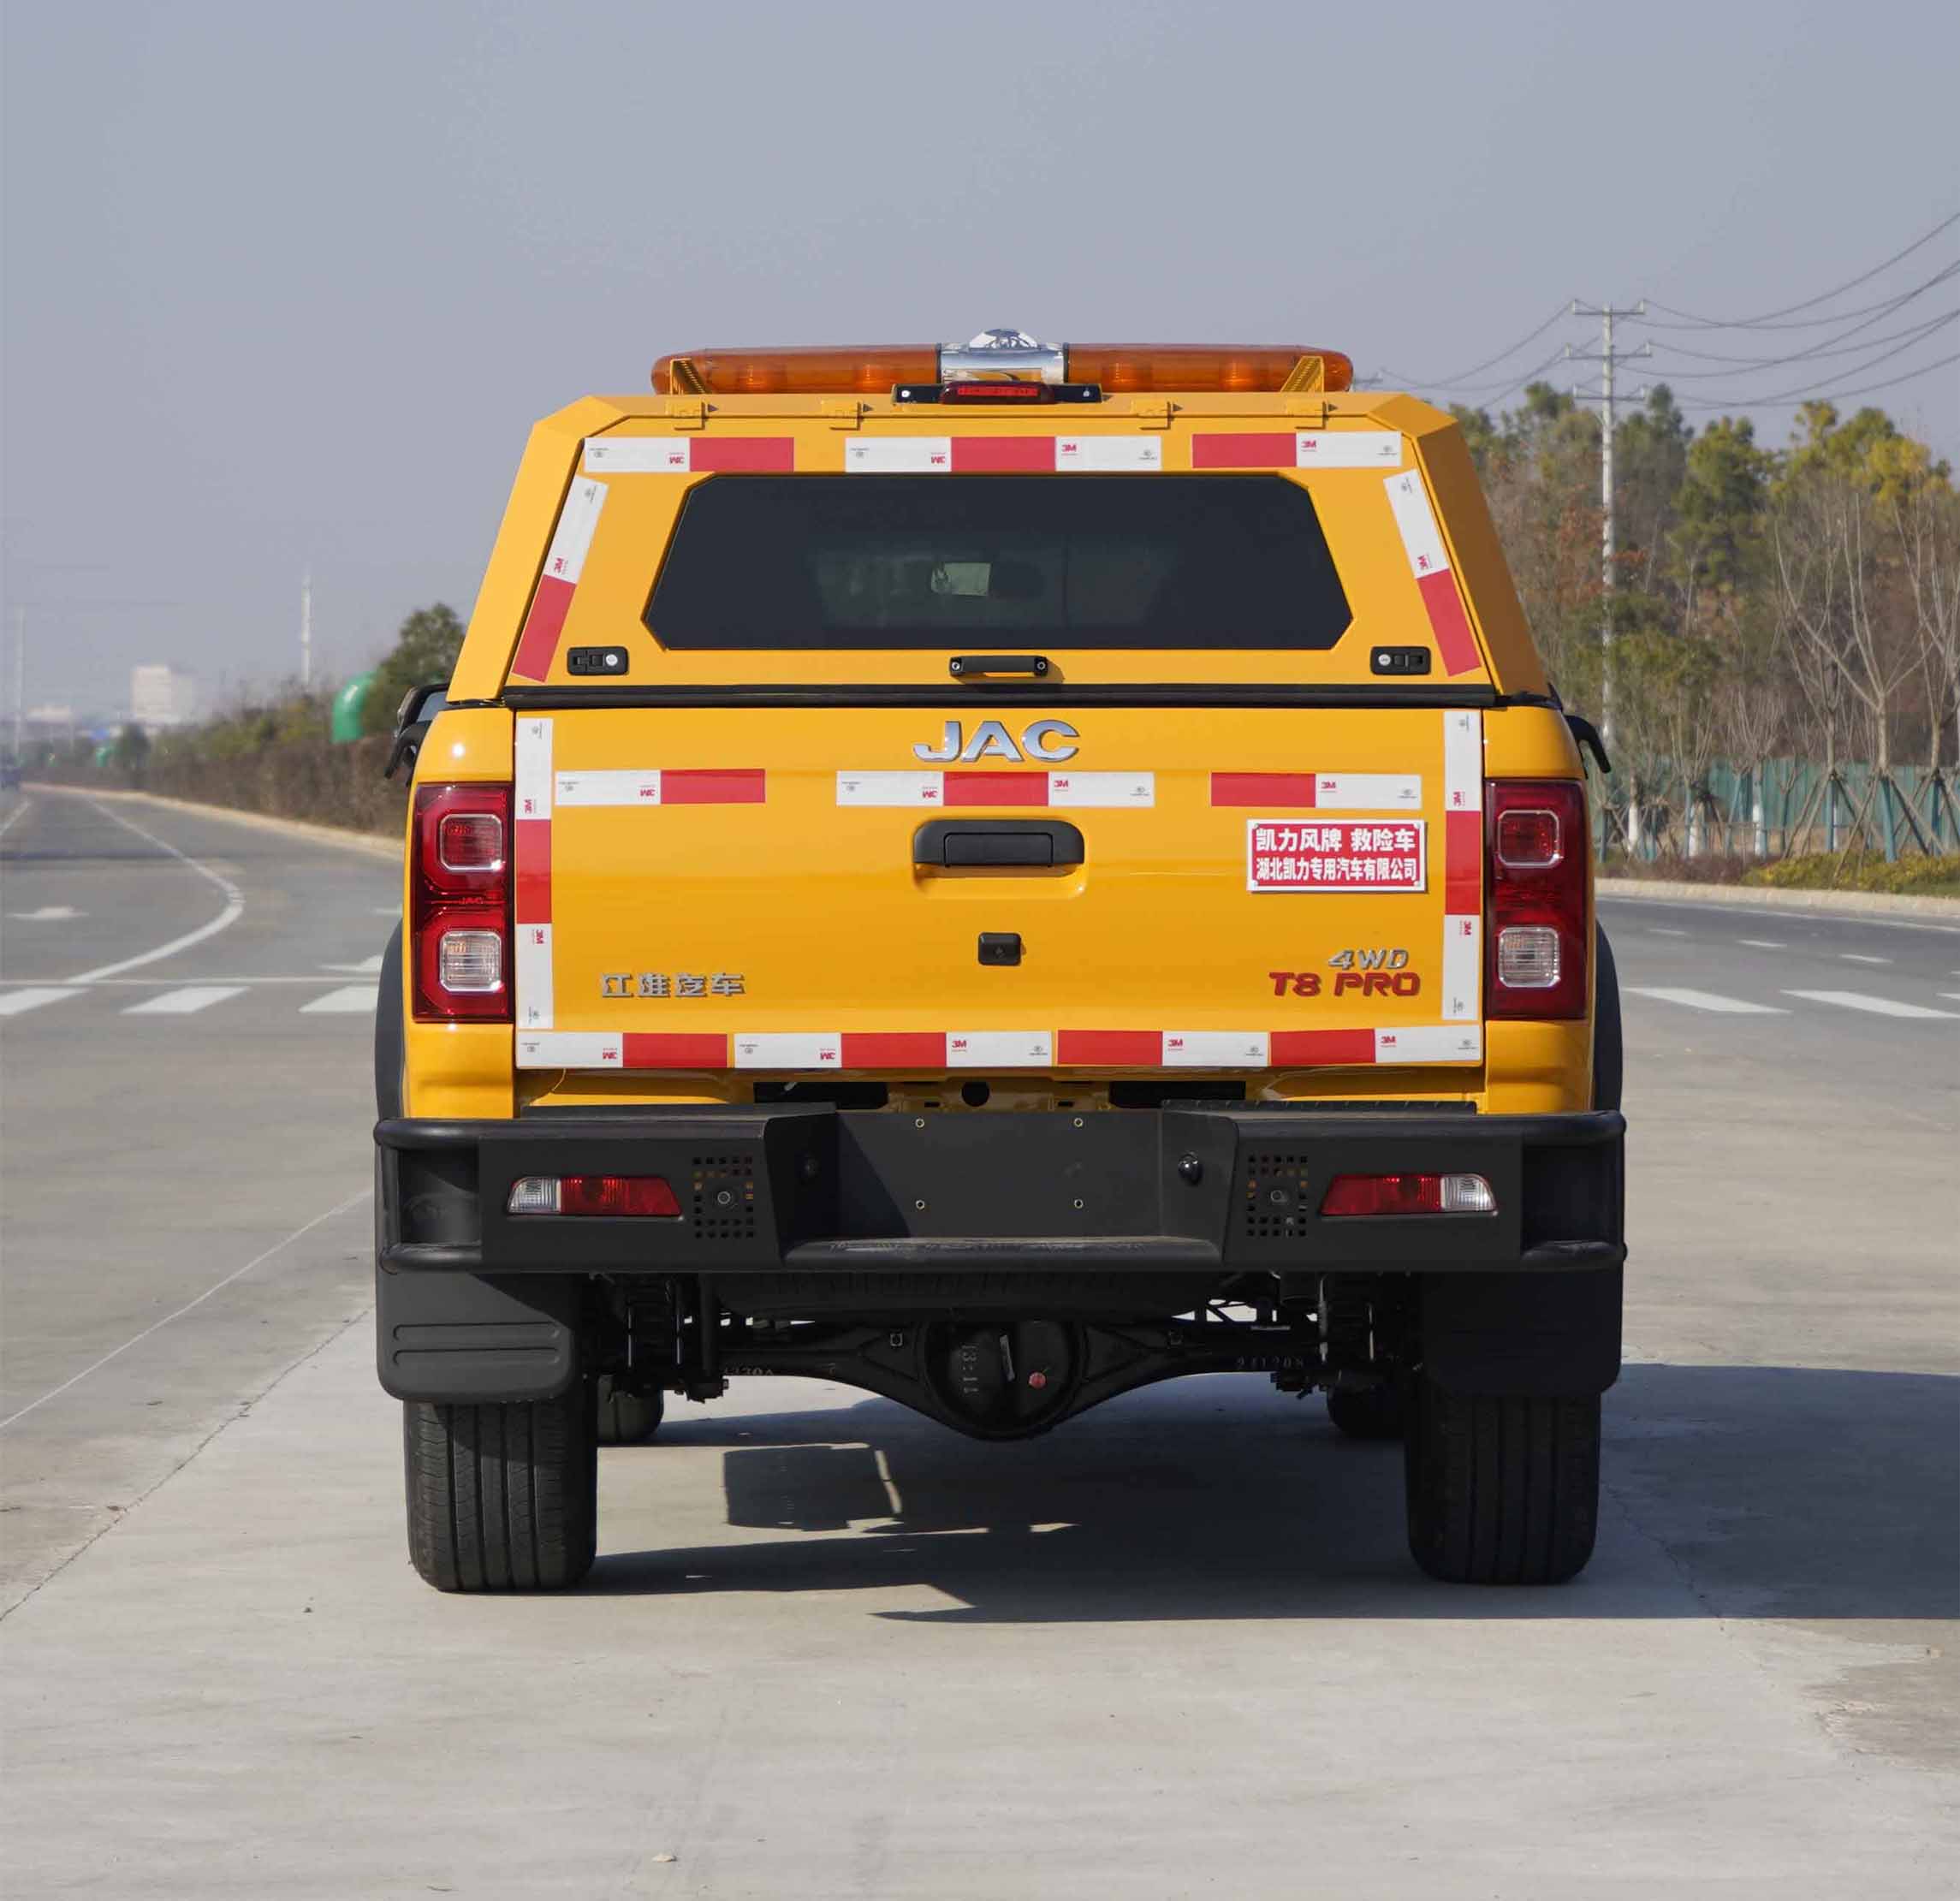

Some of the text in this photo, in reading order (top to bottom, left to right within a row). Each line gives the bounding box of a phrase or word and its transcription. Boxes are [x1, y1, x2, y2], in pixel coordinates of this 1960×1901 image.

[1303, 440, 1317, 449] 3M
[930, 455, 946, 464] 3M
[912, 719, 1080, 762] JAC
[1054, 780, 1069, 788] 3M
[922, 790, 937, 799] 3M
[1453, 791, 1462, 806] 3M
[524, 799, 532, 813] 3M
[1256, 828, 1416, 852] 凯力风牌 救险车
[1256, 857, 1417, 881] 湖北凯力专用汽车有限公司
[1463, 920, 1472, 936] 3M
[535, 929, 544, 945] 3M
[1328, 949, 1409, 970] 4WD
[602, 972, 746, 998] 江淮汽车
[1268, 971, 1421, 997] T8 PRO
[951, 1039, 967, 1049] 3M
[1167, 1038, 1184, 1048] 3M
[1381, 1035, 1397, 1044] 3M
[602, 1051, 618, 1060] 3M
[819, 1052, 836, 1060] 3M
